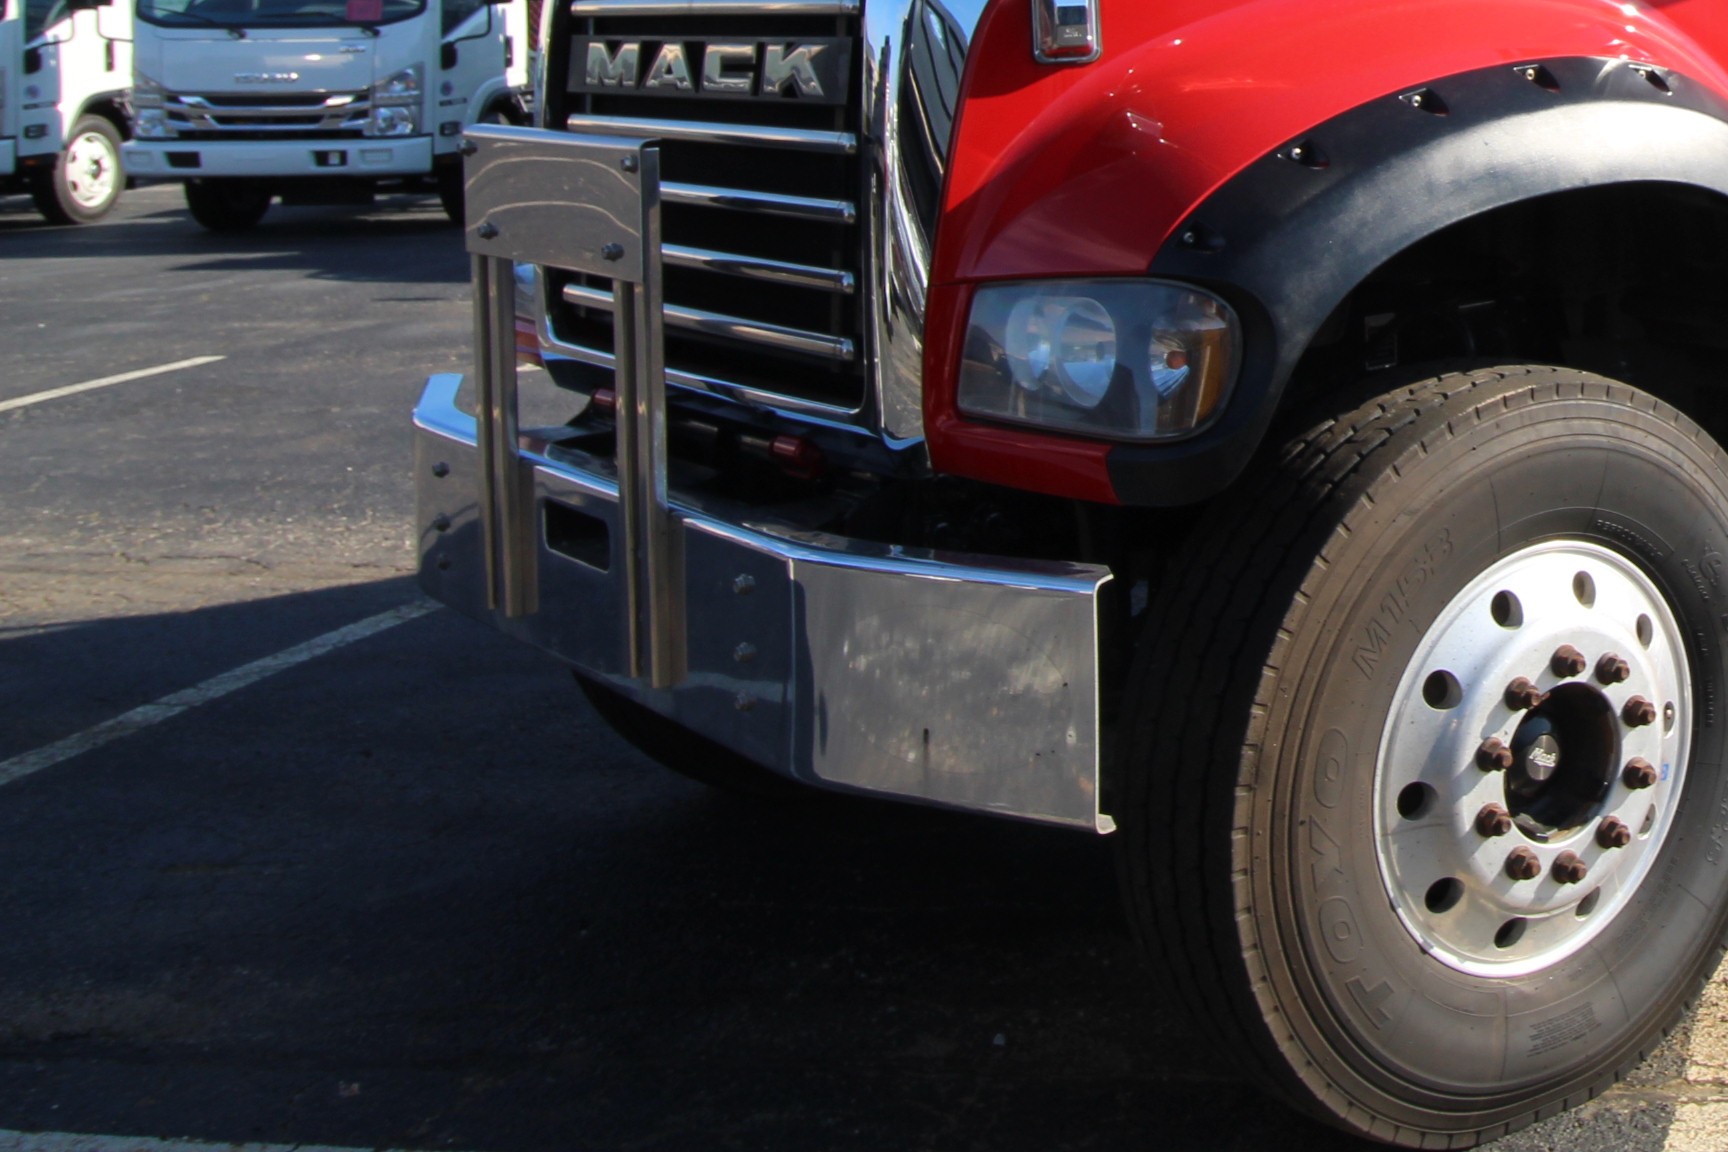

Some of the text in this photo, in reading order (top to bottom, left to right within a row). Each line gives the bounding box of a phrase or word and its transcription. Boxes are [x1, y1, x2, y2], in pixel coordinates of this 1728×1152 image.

[585, 41, 829, 97] MACK
[1351, 527, 1454, 681] M153
[1308, 727, 1395, 1030] TOYO
